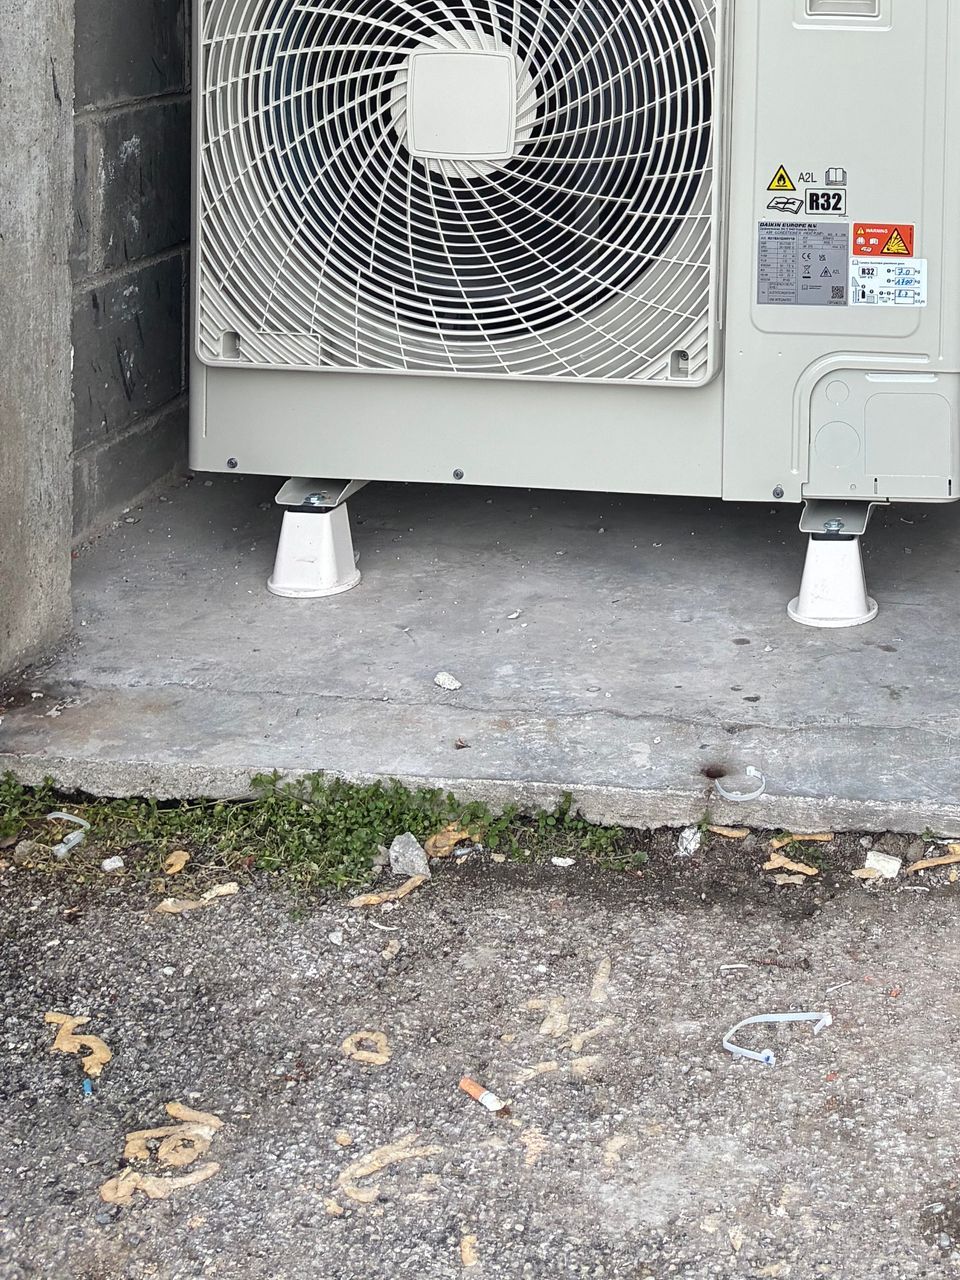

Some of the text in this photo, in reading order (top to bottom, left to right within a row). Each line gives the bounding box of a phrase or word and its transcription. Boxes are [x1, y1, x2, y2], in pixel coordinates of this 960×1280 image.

[797, 172, 818, 184] A2L
[809, 192, 842, 211] R32
[861, 267, 875, 276] R32
